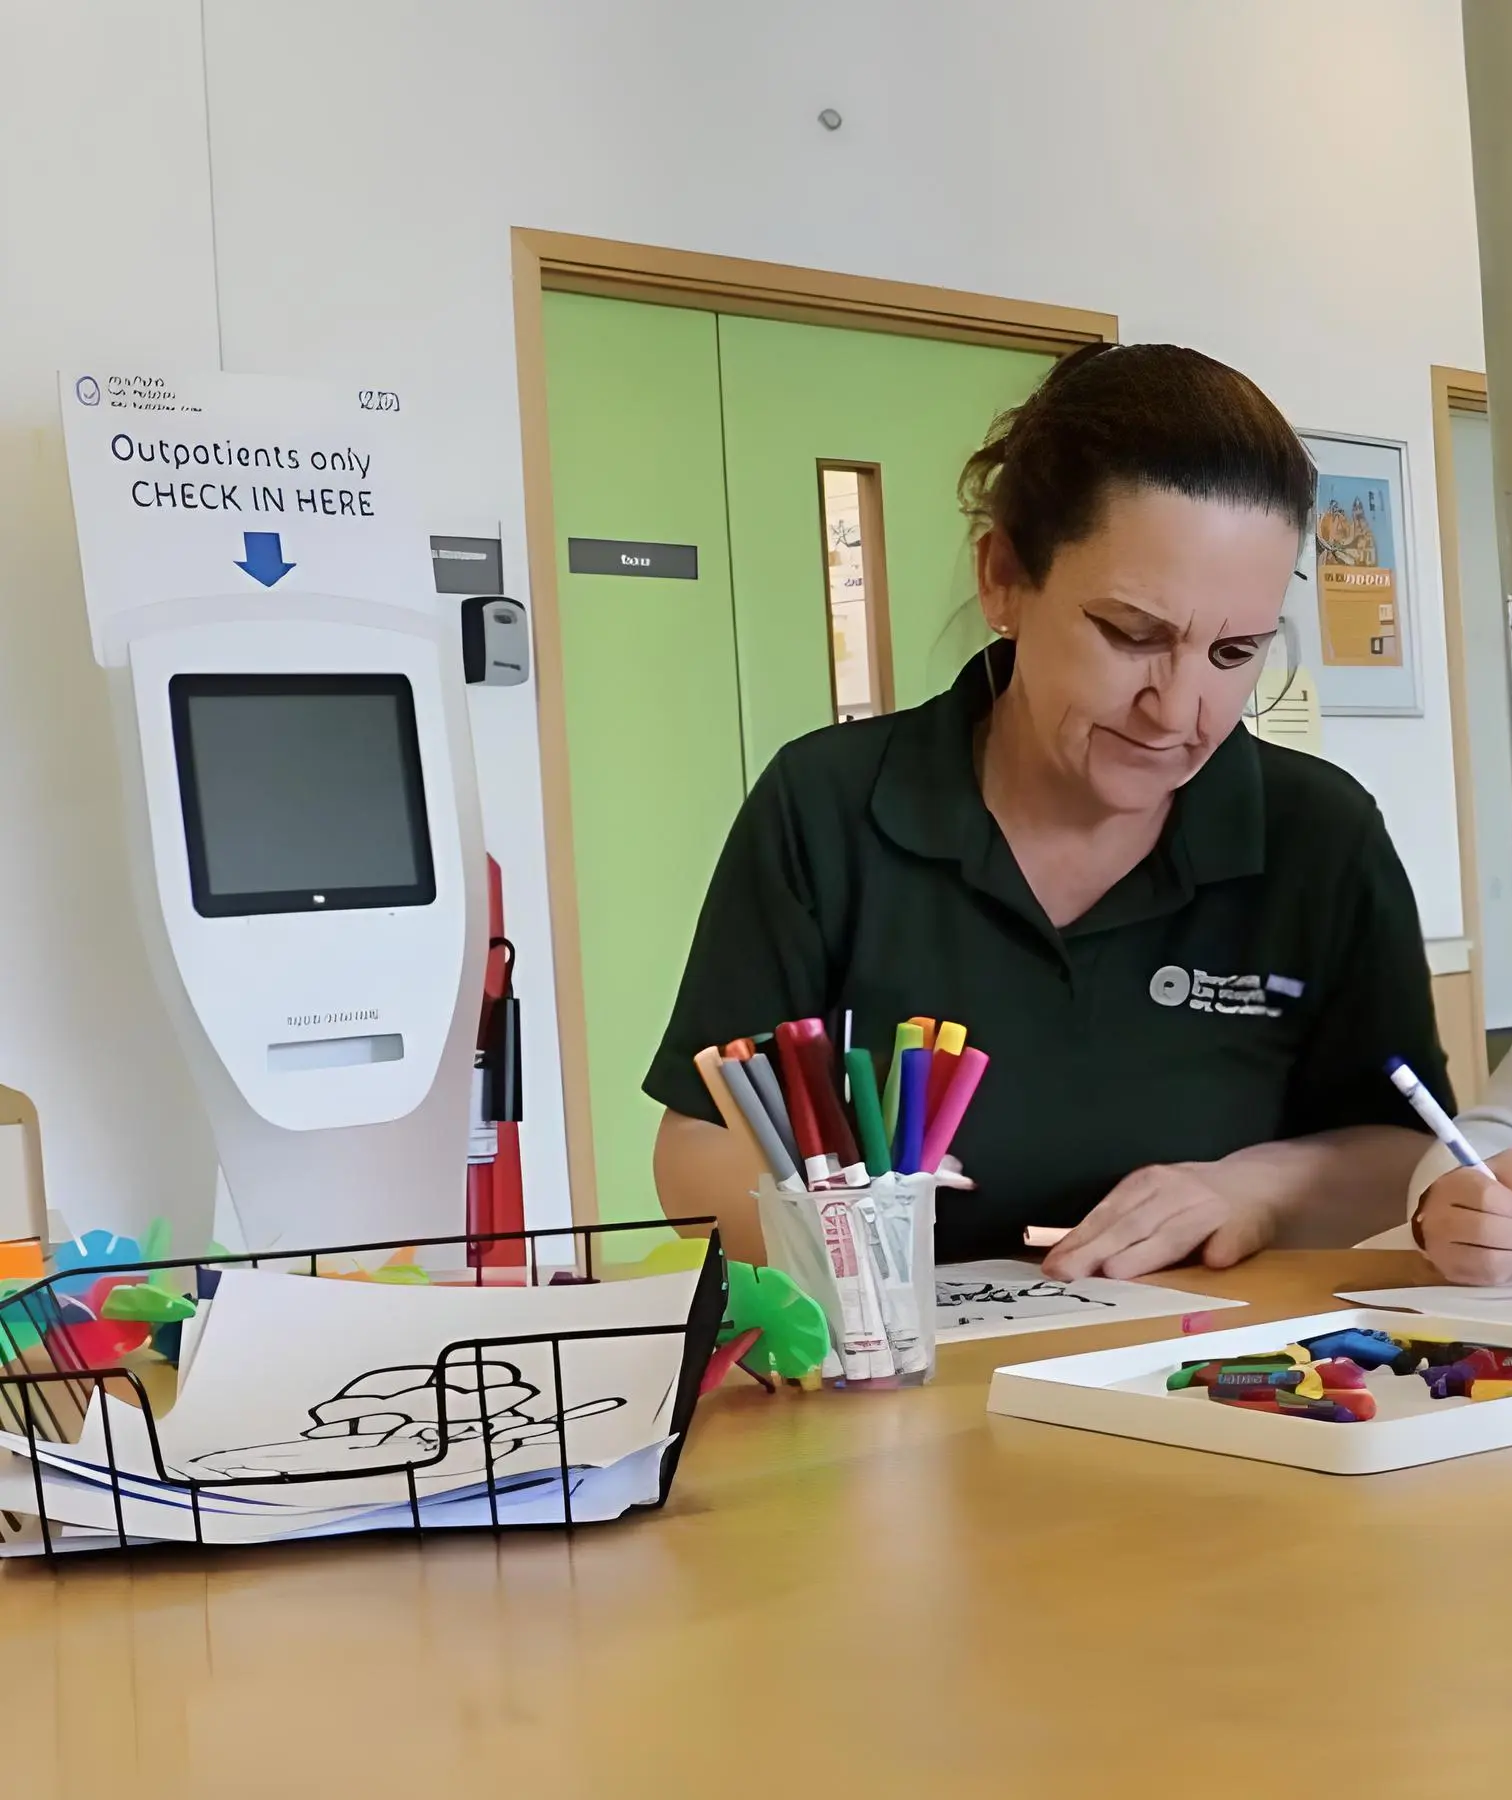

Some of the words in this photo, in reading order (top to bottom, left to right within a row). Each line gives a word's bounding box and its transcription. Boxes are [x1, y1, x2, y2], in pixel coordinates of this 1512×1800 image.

[111, 433, 300, 470] Outpatients
[310, 447, 370, 480] only
[131, 480, 242, 512] CHECK
[251, 486, 285, 513] IN
[295, 488, 375, 517] HERE
